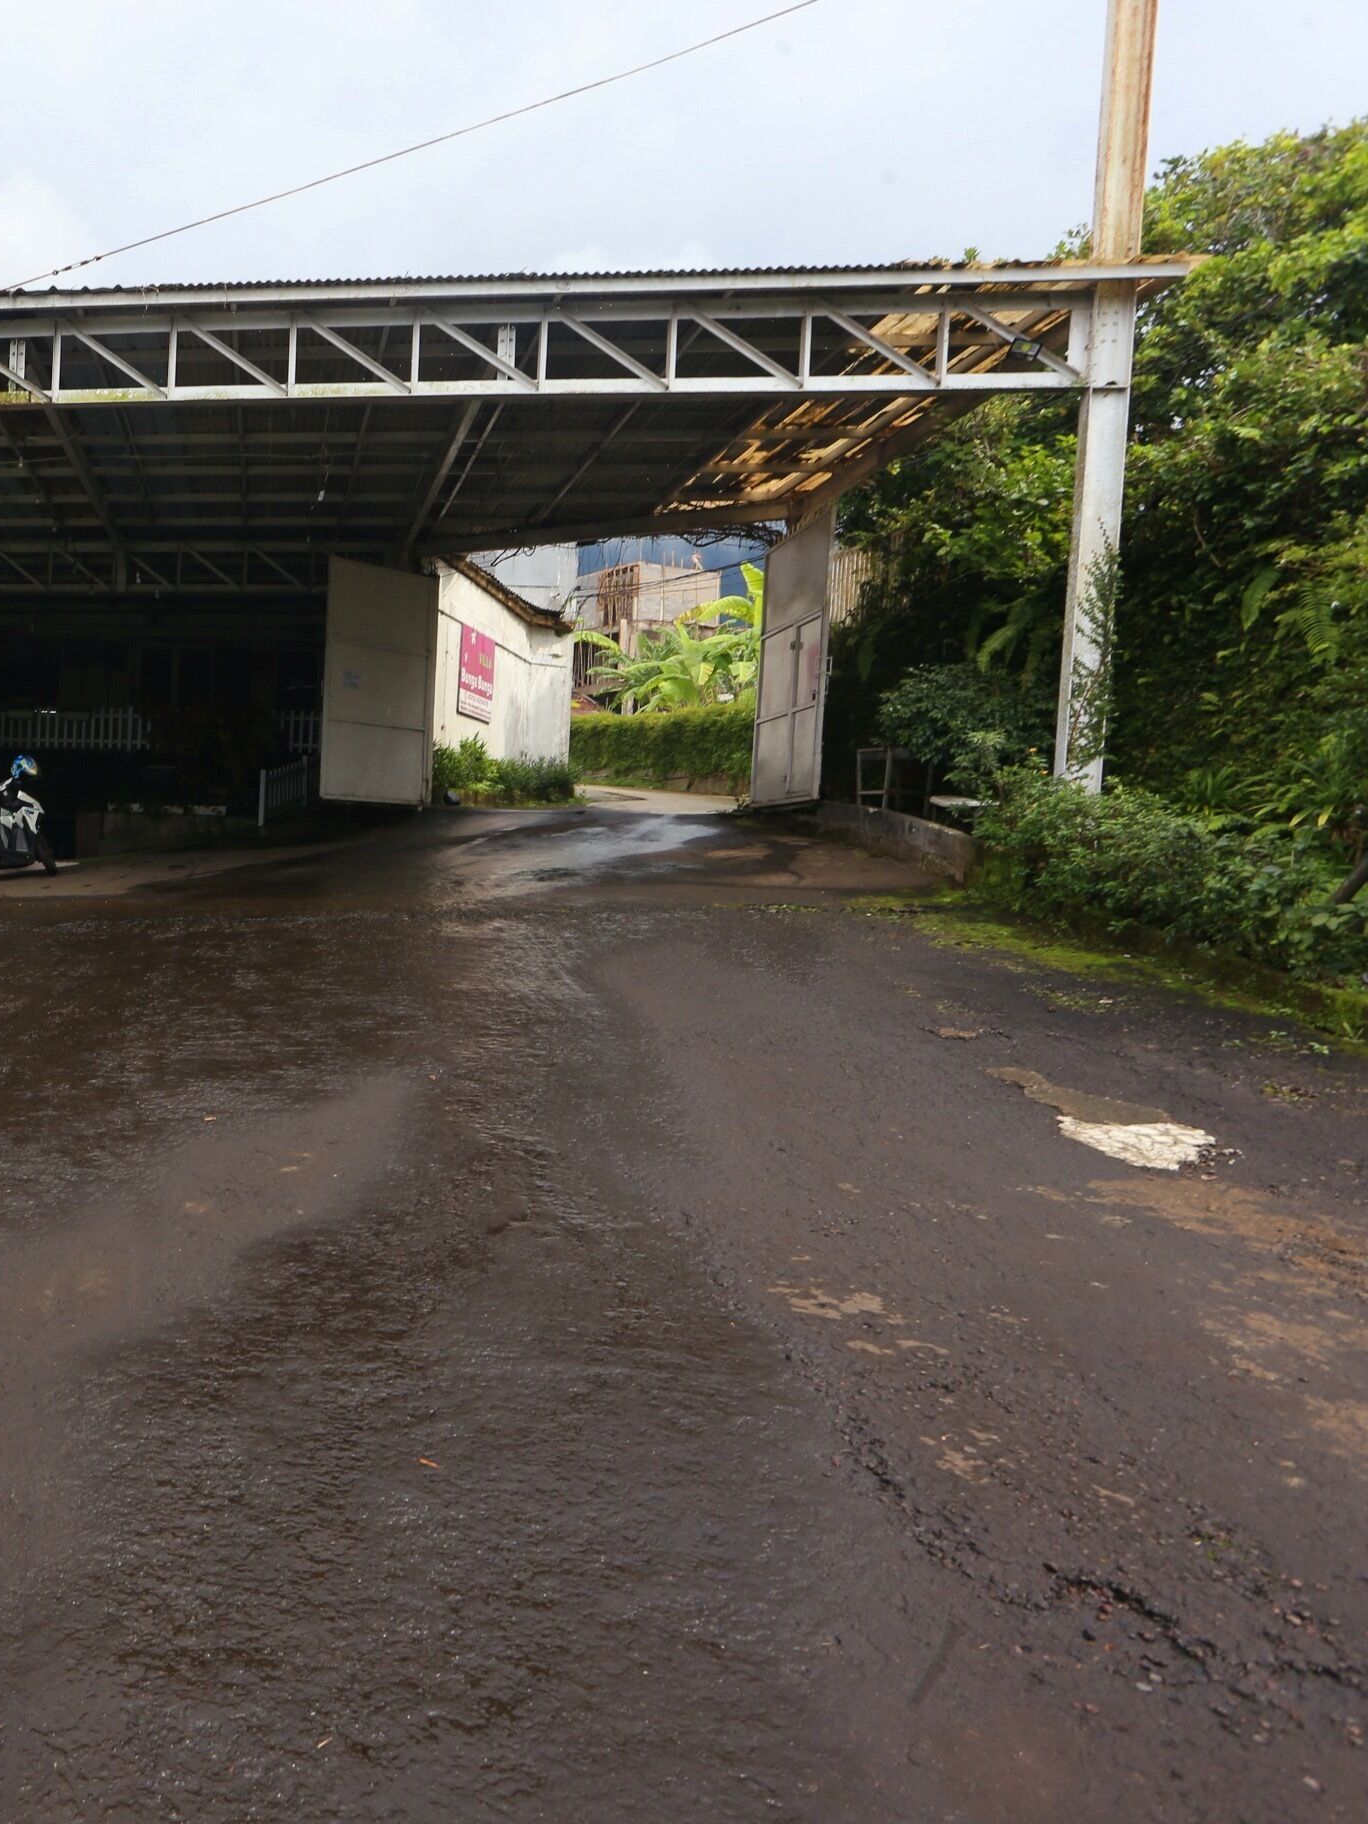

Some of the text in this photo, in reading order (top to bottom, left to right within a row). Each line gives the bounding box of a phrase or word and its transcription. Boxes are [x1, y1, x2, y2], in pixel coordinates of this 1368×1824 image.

[479, 653, 492, 668] VILLA
[461, 667, 492, 696] Bunga Bunga
